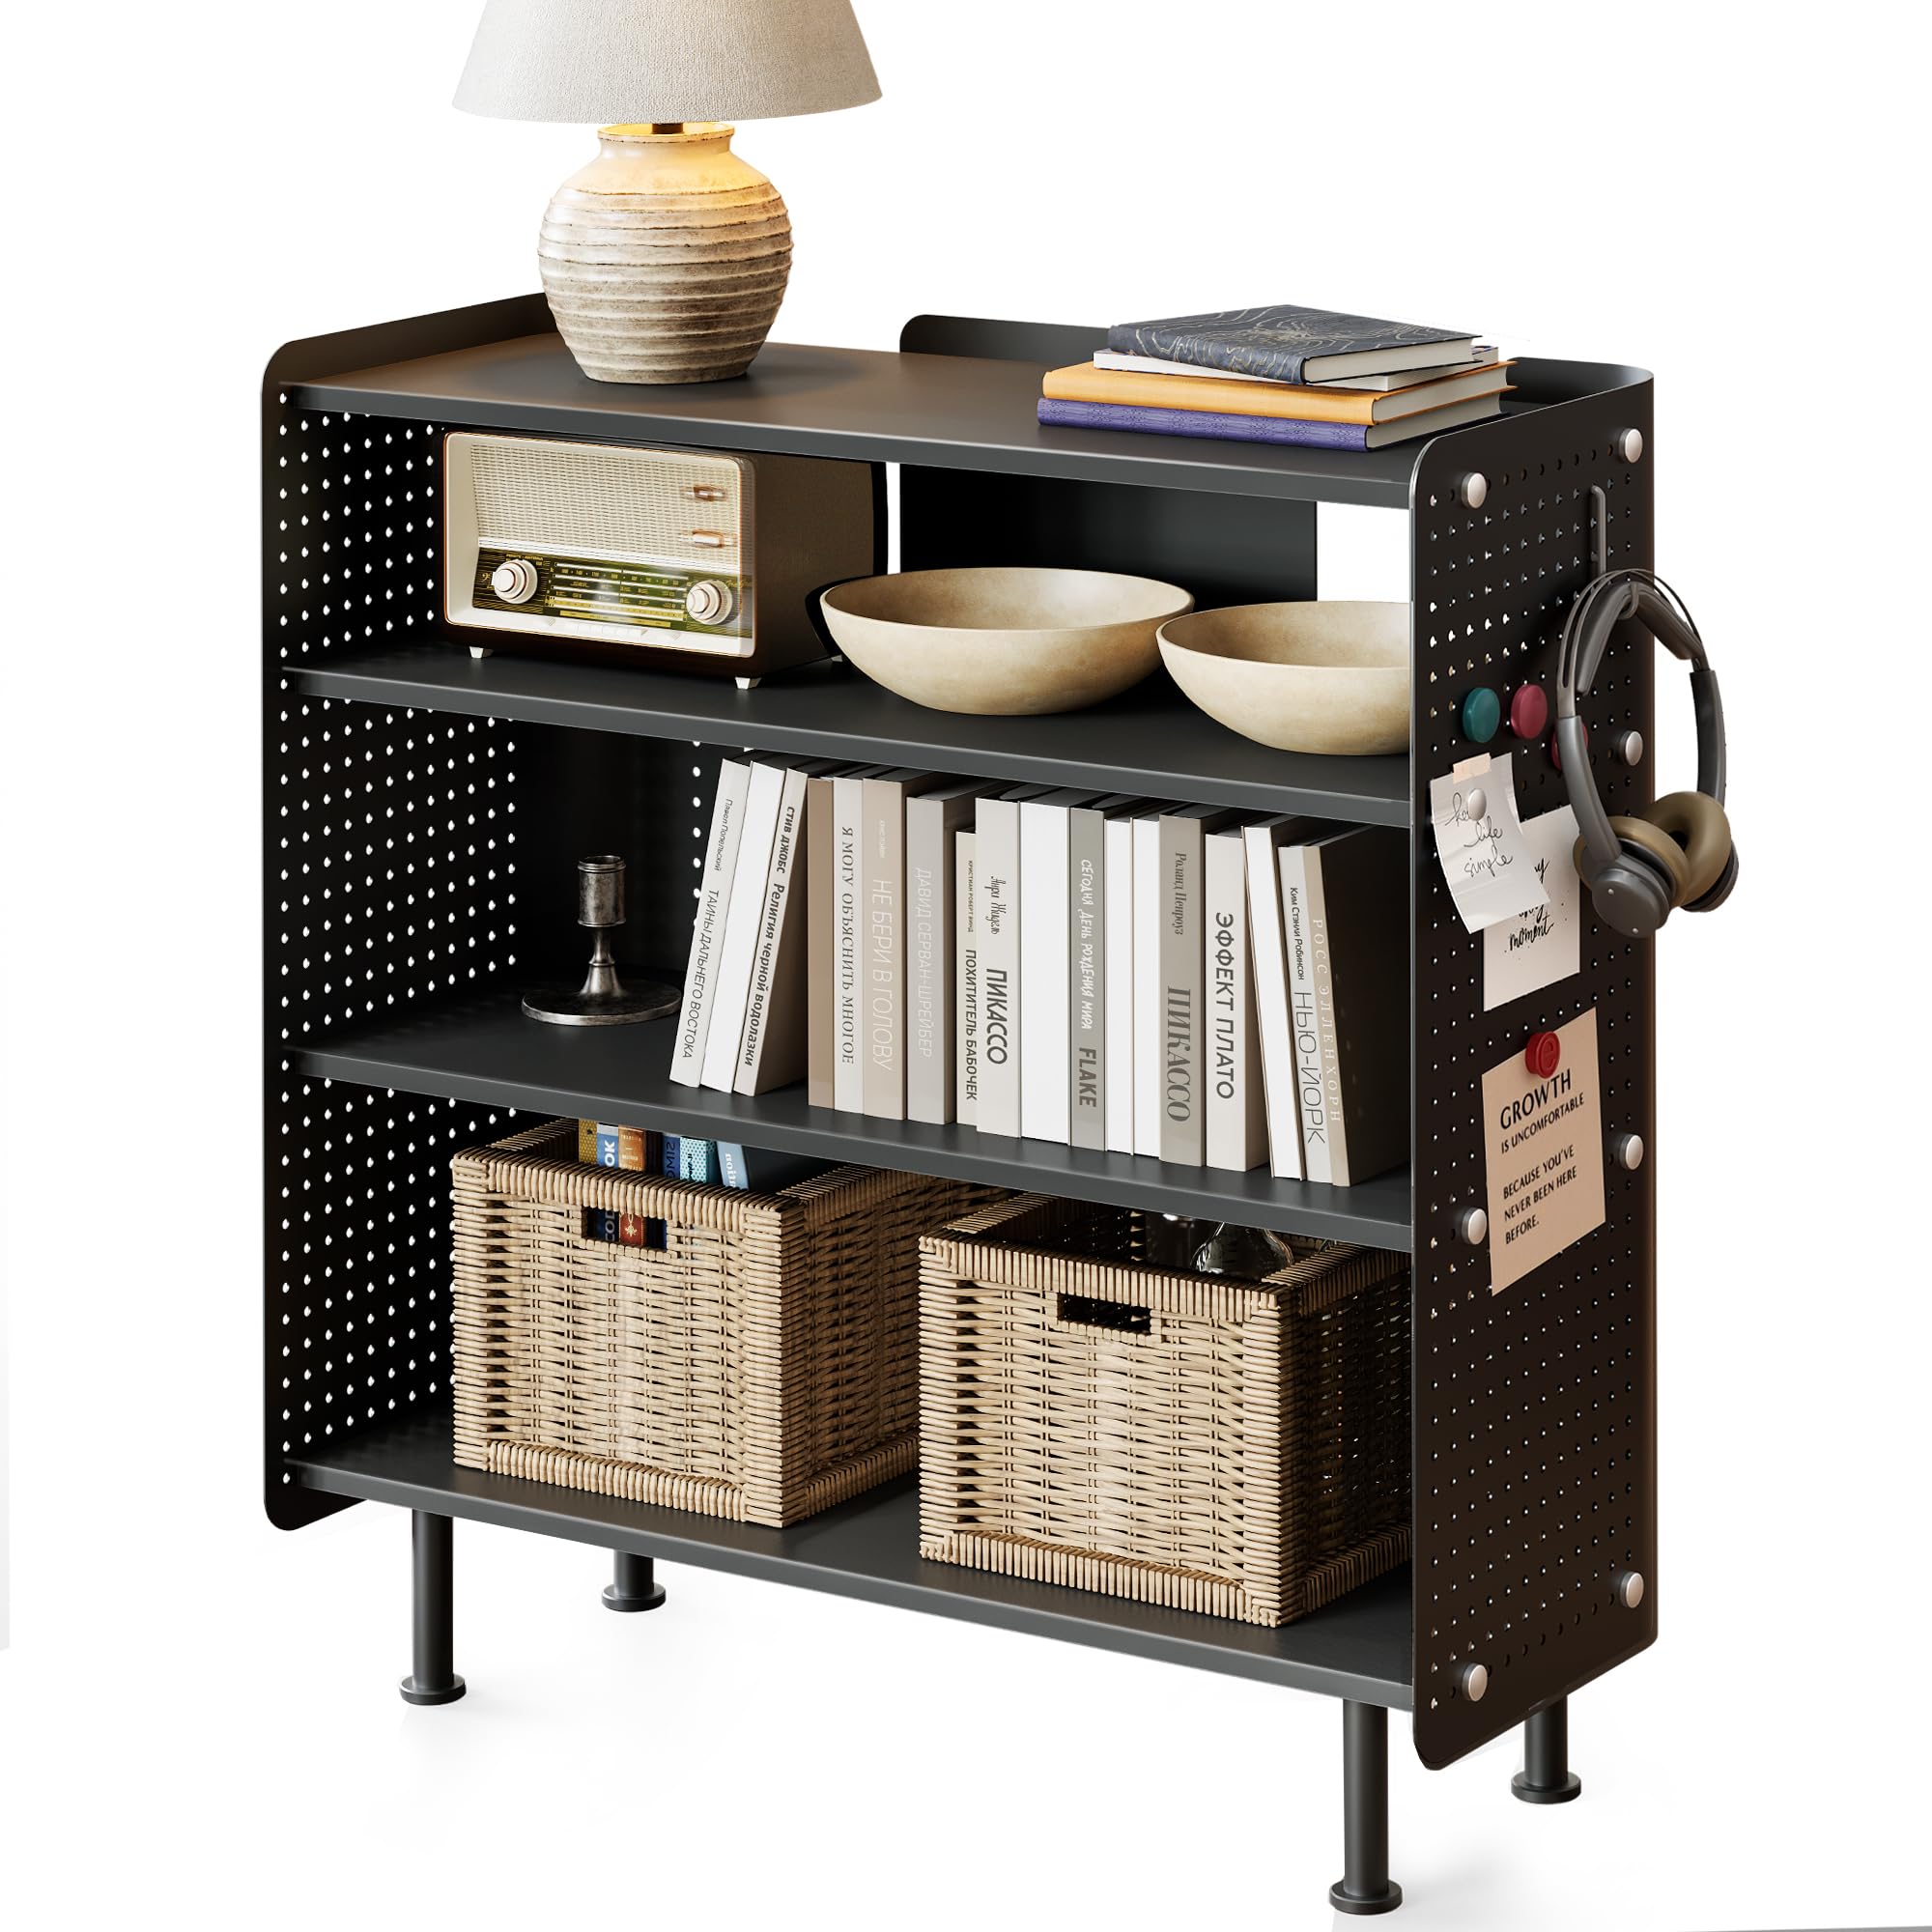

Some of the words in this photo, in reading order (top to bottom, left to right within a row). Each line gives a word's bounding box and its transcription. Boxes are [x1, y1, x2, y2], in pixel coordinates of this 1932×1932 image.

[841, 826, 854, 837] Я
[1463, 815, 1503, 847] life
[841, 841, 854, 887] МОГУ
[1080, 859, 1094, 905] СЕГОДНЯ
[1173, 852, 1187, 890] Роланд
[1463, 845, 1513, 877] simple
[765, 883, 785, 939] Религия
[872, 879, 893, 905] НЕ
[914, 867, 933, 918] ДАВИД
[1172, 893, 1187, 935] Пенроуз
[841, 893, 854, 990] ОБЪЯСНИТЬ
[872, 911, 893, 965] БЕРИ
[1077, 908, 1094, 939] ДЕНЬ
[1292, 906, 1301, 937] Стэнли
[1509, 914, 1554, 951] moment
[692, 932, 712, 999] ДАЛЬНЕГО
[756, 943, 774, 992] черной
[872, 969, 893, 982] В
[1080, 943, 1094, 997] РОЖДЕНИЯ
[1214, 912, 1235, 1011] ЭФФЕКТ
[1295, 938, 1305, 980] Робинсон
[965, 950, 978, 1037] ПОХИТИТЕЛЬ
[986, 968, 1008, 1065] ПИКАССО
[1081, 1000, 1094, 1030] МИРА
[682, 1001, 701, 1059] ВОСТОКА
[744, 993, 764, 1066] водолазки
[841, 996, 854, 1065] МНОГОЕ
[872, 988, 893, 1071] ГОЛОВУ
[1166, 985, 1191, 1122] ПИКАССО
[966, 1040, 978, 1101] БАБОЧЕК
[1079, 1047, 1097, 1108] FLAKE
[1216, 1017, 1235, 1099] ПЛАТО
[1293, 992, 1326, 1144] НЬЮ-ЙОРК
[1500, 1068, 1572, 1129] GROWTH
[1501, 1139, 1509, 1154] IS
[1511, 1092, 1584, 1147] UNCOMFORTABLE
[1503, 1166, 1541, 1200] BECAUSE
[1543, 1145, 1575, 1174] YOU'VE
[1504, 1199, 1531, 1222] NEVER
[1533, 1181, 1554, 1205] BEEN
[1556, 1166, 1577, 1189] HERE
[1505, 1213, 1540, 1244] BEFORE.
